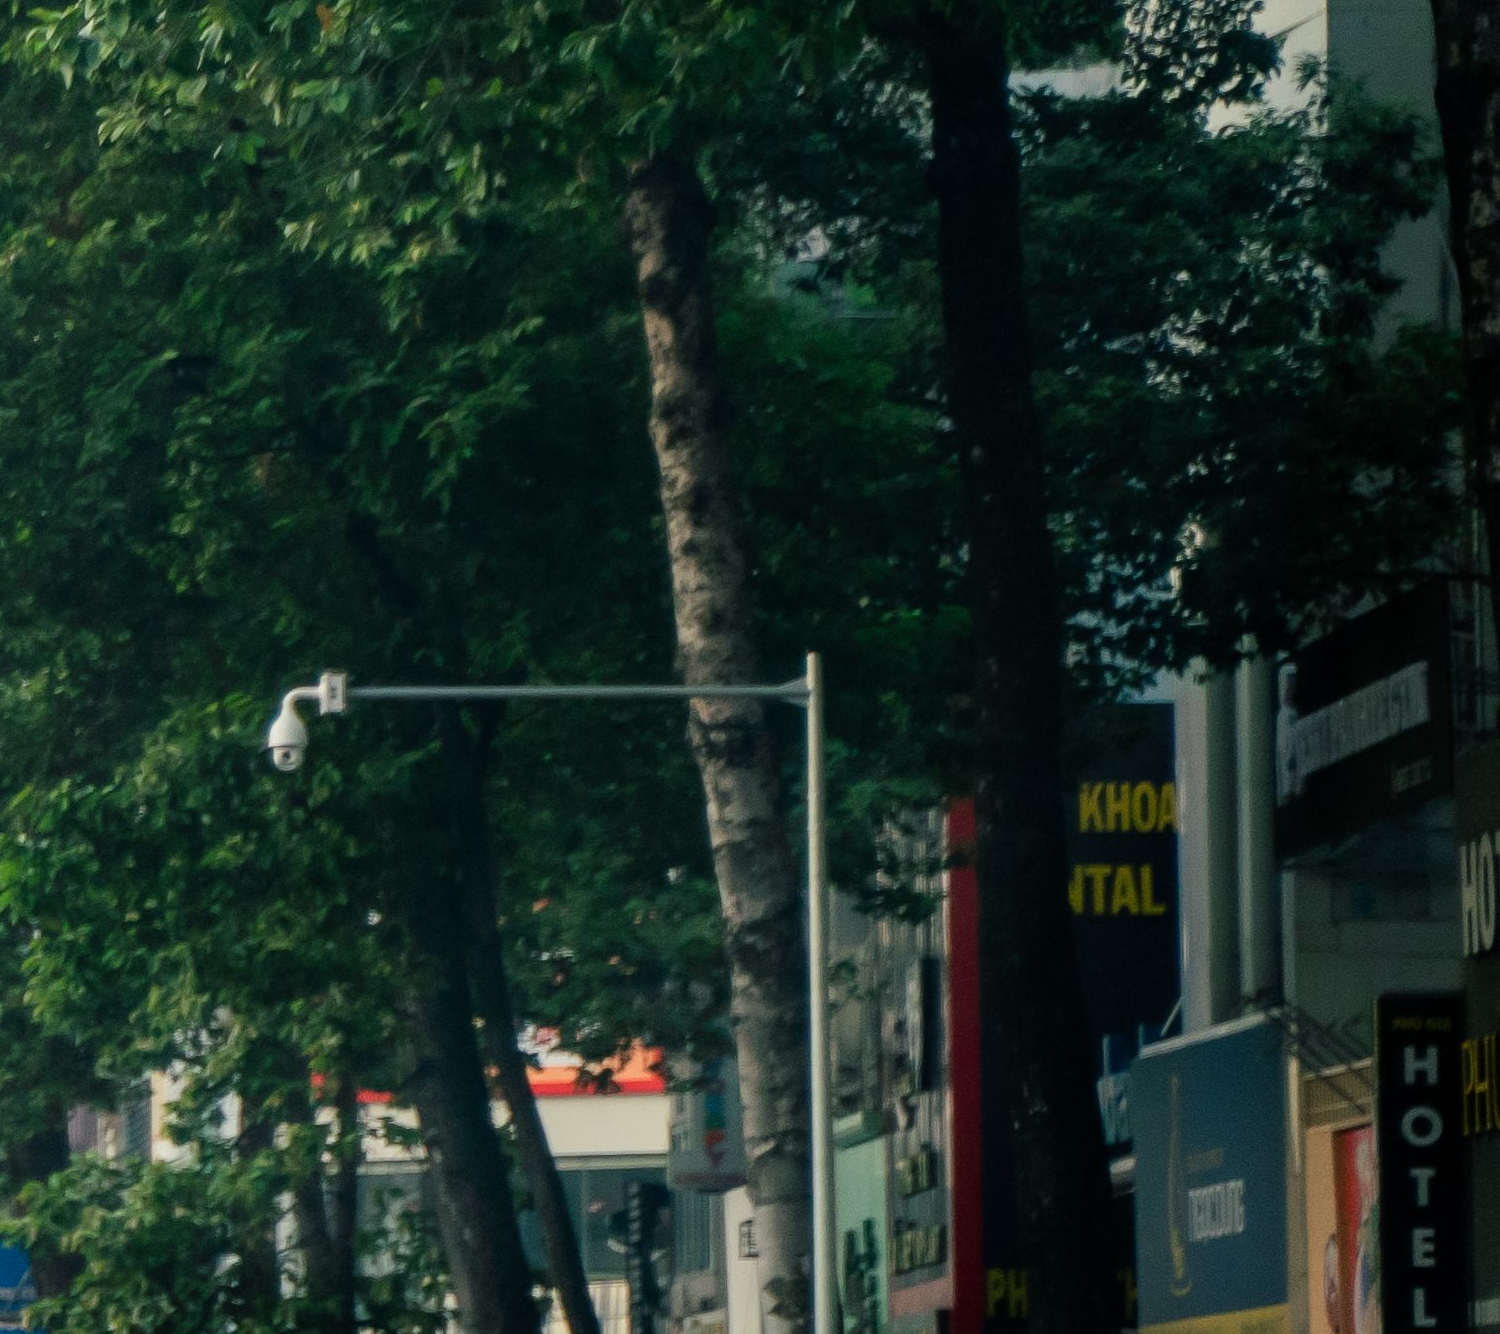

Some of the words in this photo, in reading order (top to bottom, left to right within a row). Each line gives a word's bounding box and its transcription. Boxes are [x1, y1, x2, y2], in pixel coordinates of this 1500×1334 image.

[1078, 780, 1179, 834] KHOA
[1459, 830, 1500, 959] HO
[1399, 1043, 1445, 1328] HOTEL
